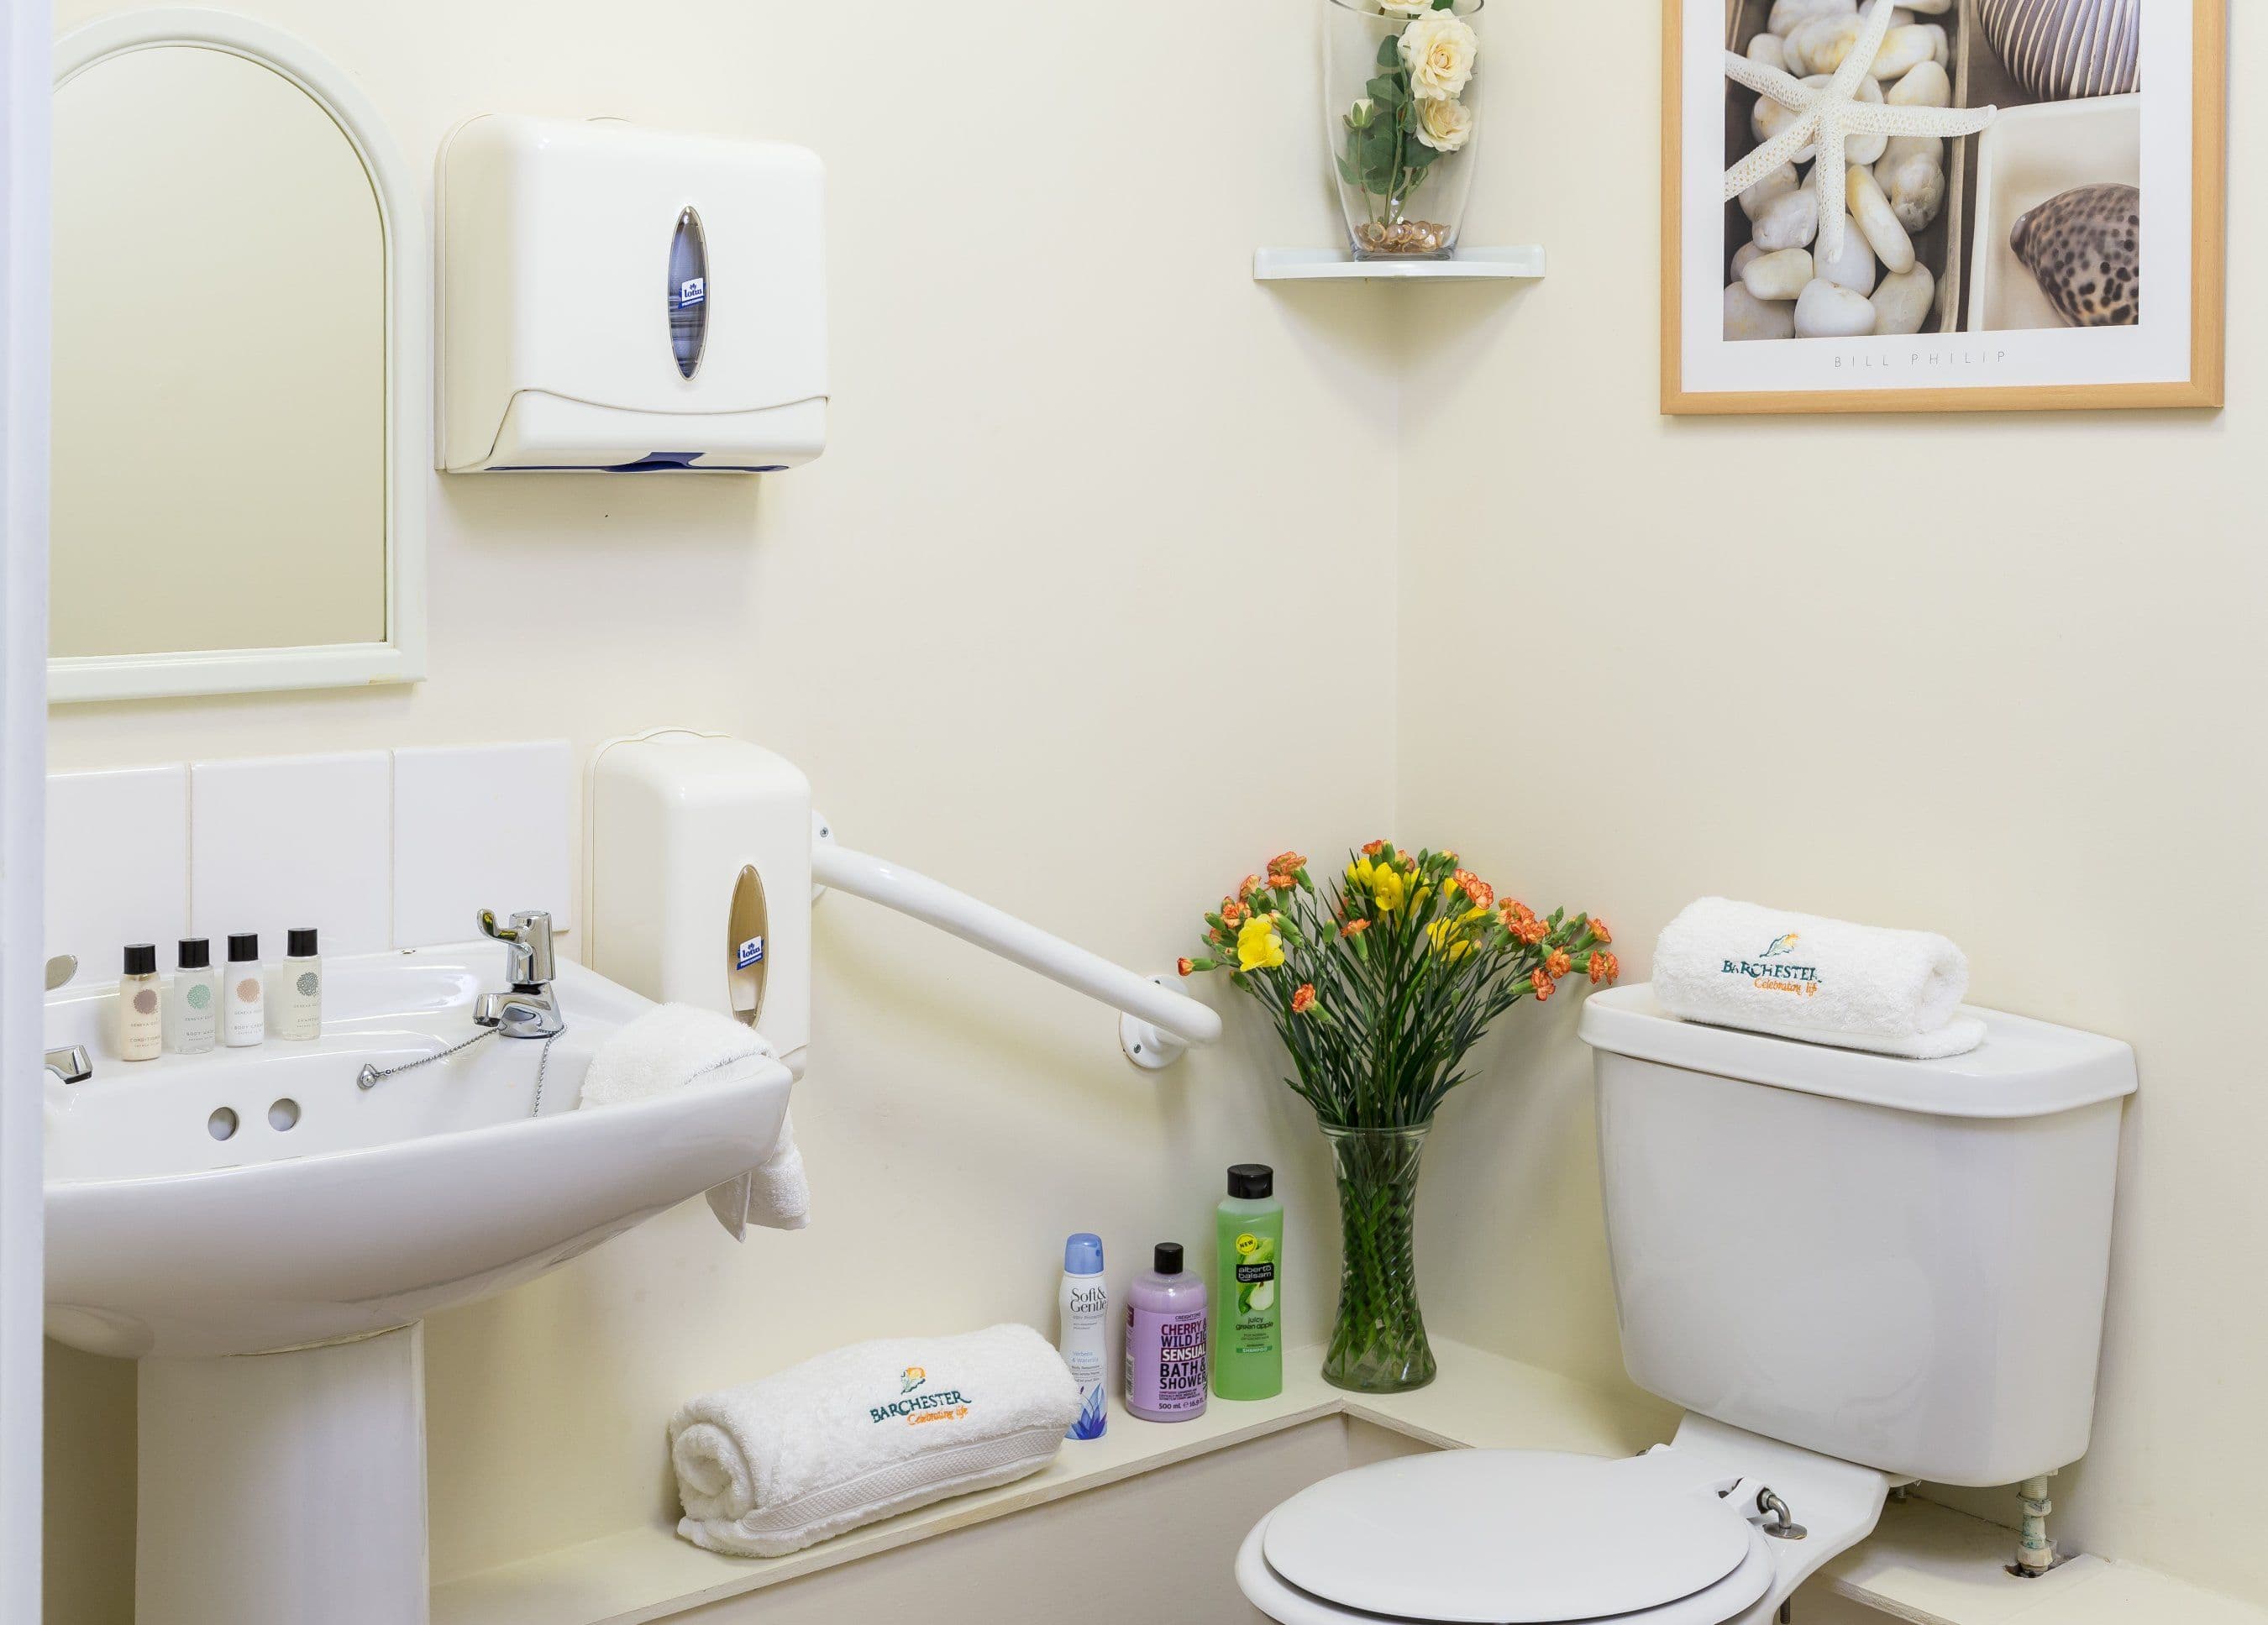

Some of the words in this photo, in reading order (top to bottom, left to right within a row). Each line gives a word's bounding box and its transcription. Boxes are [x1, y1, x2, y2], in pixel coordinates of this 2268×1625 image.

[685, 289, 702, 297] lotus
[1834, 355, 1889, 368] BILL
[1911, 351, 2005, 365] PHILIP
[1239, 1239, 1253, 1248] NEW
[1238, 1265, 1272, 1273] alberto
[1238, 1271, 1272, 1280] balsam
[1070, 1299, 1106, 1313] Gentle
[1247, 1316, 1264, 1324] juicy
[1256, 1321, 1273, 1329] apple
[1161, 1320, 1202, 1335] CHERRY
[1161, 1335, 1192, 1347] WILD
[1162, 1343, 1206, 1361] SENSUAL
[1160, 1360, 1199, 1377] BATH
[1200, 1357, 1205, 1371] &
[1159, 1371, 1206, 1390] SHOWER
[869, 1390, 972, 1423] BARCHESTER
